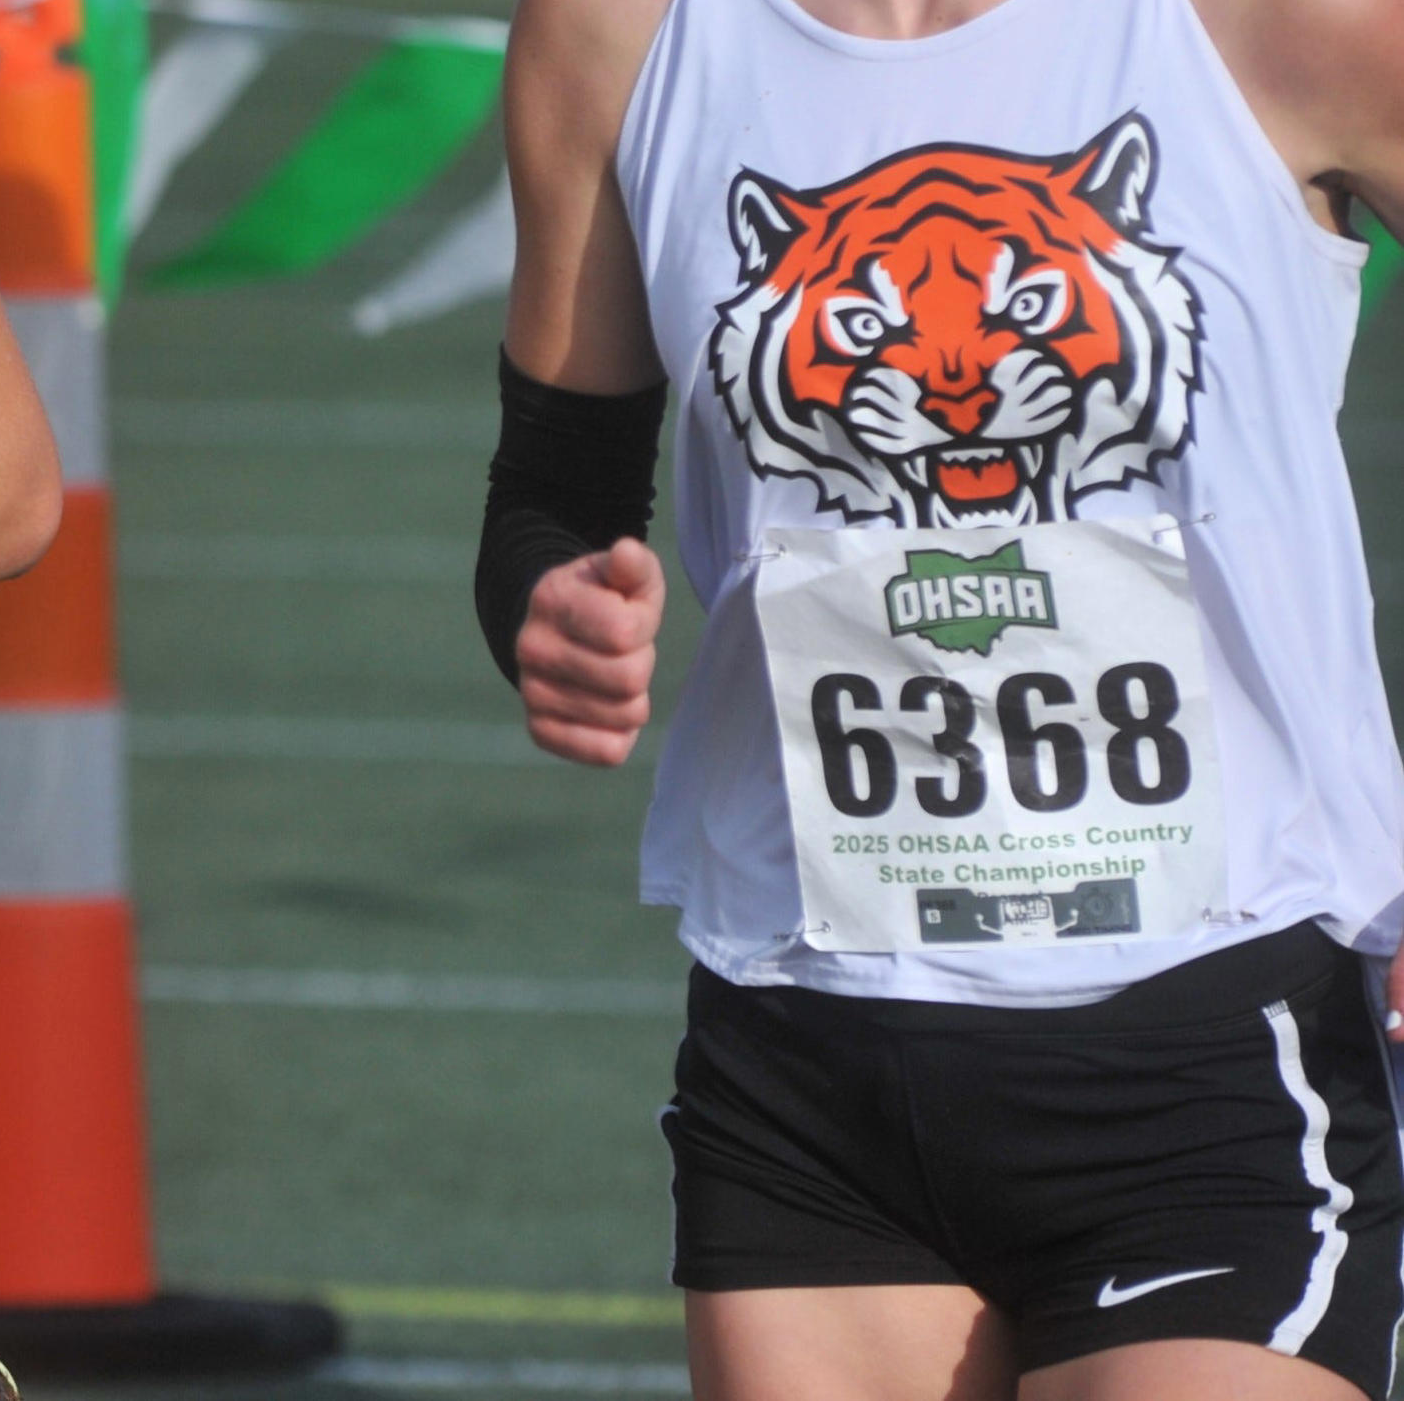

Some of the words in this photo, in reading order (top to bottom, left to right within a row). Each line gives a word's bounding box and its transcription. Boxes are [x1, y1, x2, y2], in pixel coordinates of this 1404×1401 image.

[892, 574, 1048, 626] OHSAA
[810, 661, 1192, 819] 6368
[832, 834, 889, 854] 2025
[898, 834, 991, 854] OHSAA
[999, 829, 1076, 851] Cross
[1085, 823, 1194, 846] Country
[878, 864, 944, 884] State
[954, 855, 1146, 885] Championship
